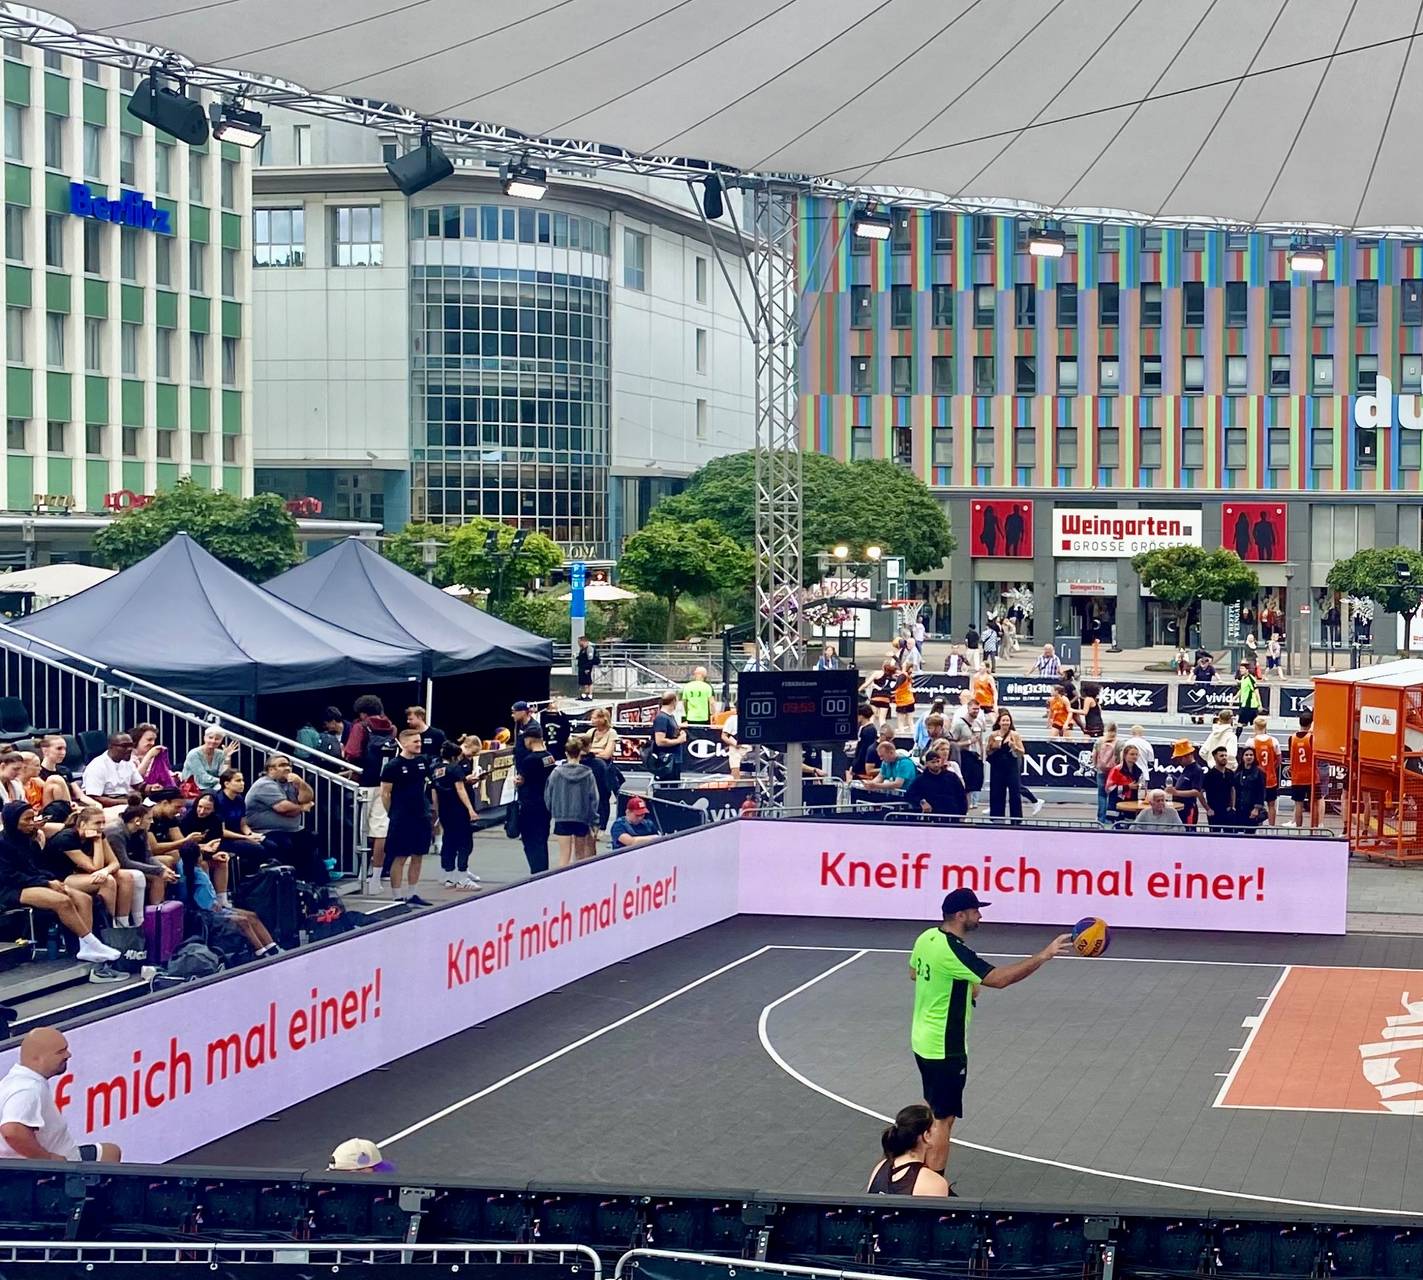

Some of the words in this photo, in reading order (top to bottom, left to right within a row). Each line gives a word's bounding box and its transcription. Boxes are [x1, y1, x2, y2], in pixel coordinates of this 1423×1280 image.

[70, 183, 171, 234] Berlitz
[1062, 515, 1181, 540] Weingarten
[1073, 541, 1125, 552] GROSSE
[1131, 539, 1187, 552] GRÖSSE
[831, 581, 869, 593] ROSS
[751, 702, 771, 715] 00
[826, 699, 846, 712] 00
[1365, 714, 1381, 726] ING
[1261, 751, 1268, 766] 3
[1298, 748, 1307, 763] 2
[1024, 753, 1068, 777] NG
[820, 852, 930, 890] Kneif
[942, 858, 1041, 894] mich
[1056, 861, 1134, 898] mal
[1148, 863, 1265, 902] einer!
[448, 918, 515, 988] Kneif
[520, 898, 573, 958] mich
[579, 880, 616, 937] mal
[623, 866, 677, 920] einer!
[87, 1039, 192, 1132] mich
[207, 1005, 277, 1084] mal
[289, 969, 381, 1050] einer!
